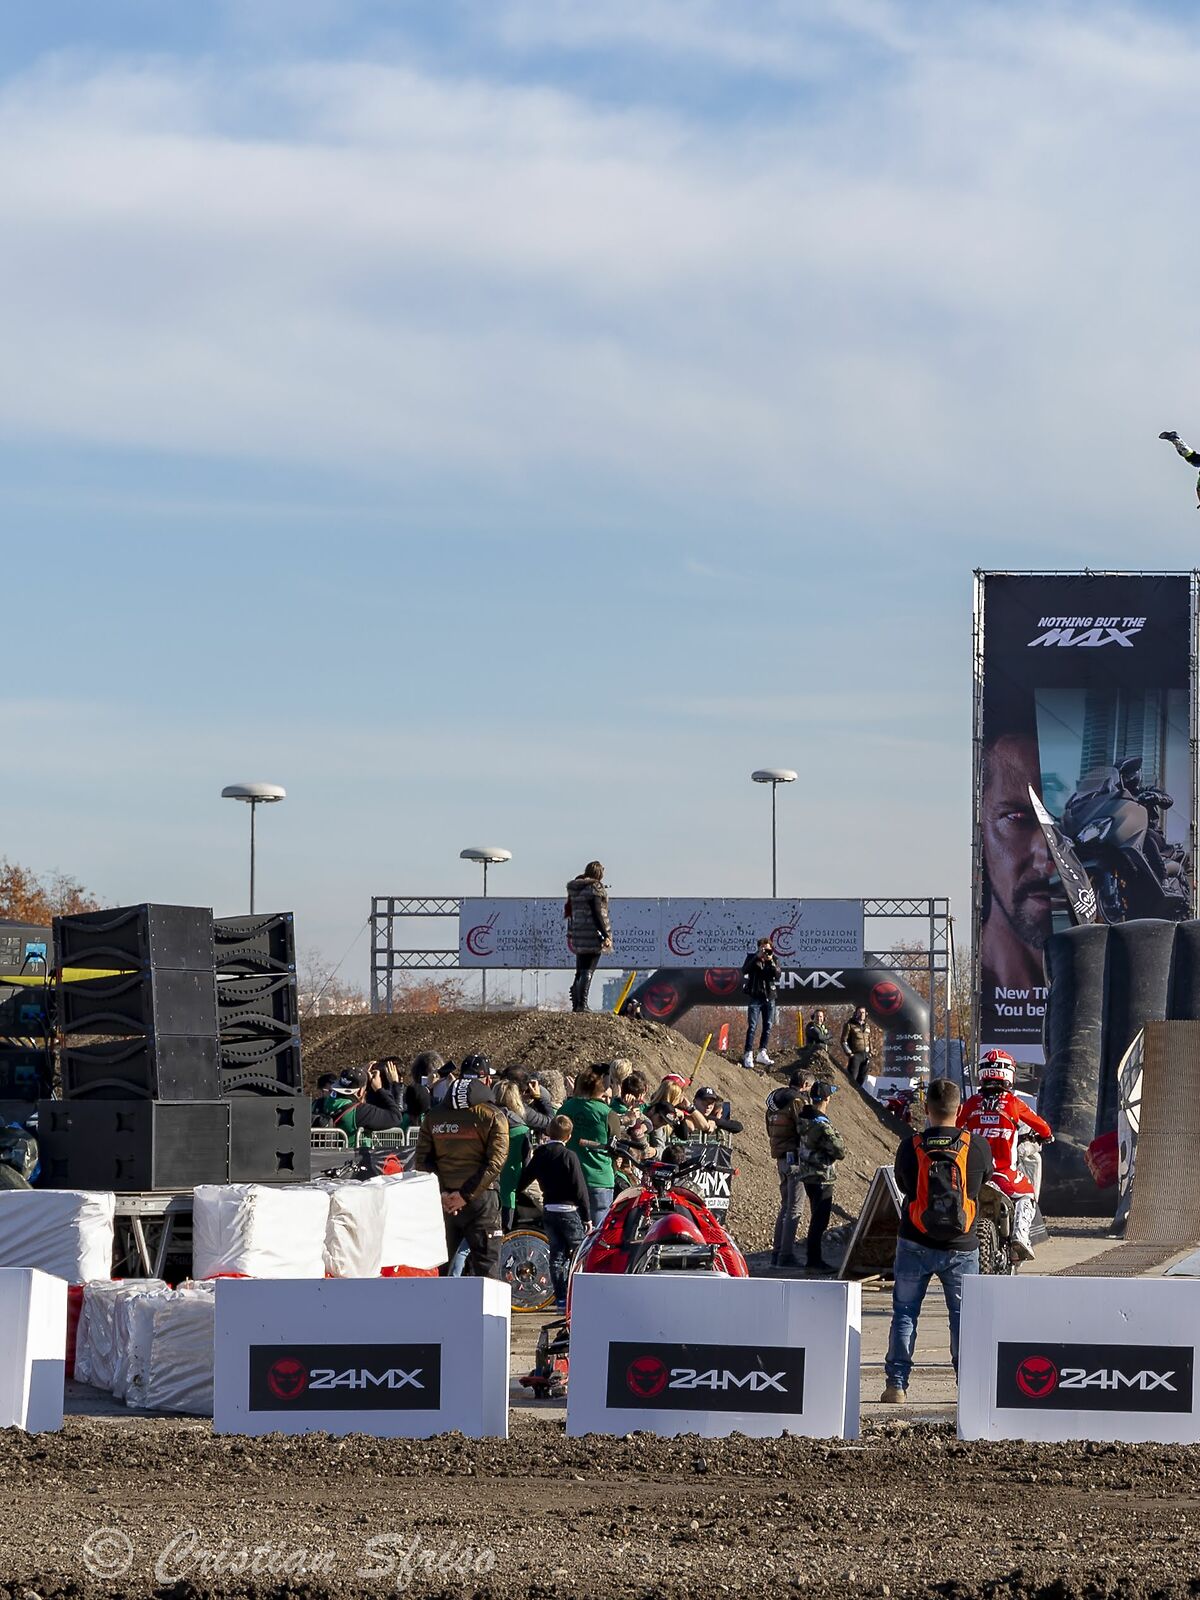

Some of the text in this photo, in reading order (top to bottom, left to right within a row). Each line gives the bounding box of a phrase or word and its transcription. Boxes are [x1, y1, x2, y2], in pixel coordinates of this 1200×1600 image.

[1038, 617, 1147, 627] NOTHING BUT THE
[1027, 628, 1141, 647] MAX
[775, 971, 846, 989] 4MX
[995, 987, 1030, 999] New
[995, 1003, 1023, 1016] You
[309, 1369, 424, 1388] 24MX
[669, 1369, 788, 1392] 24MX
[1059, 1369, 1177, 1391] 24MX
